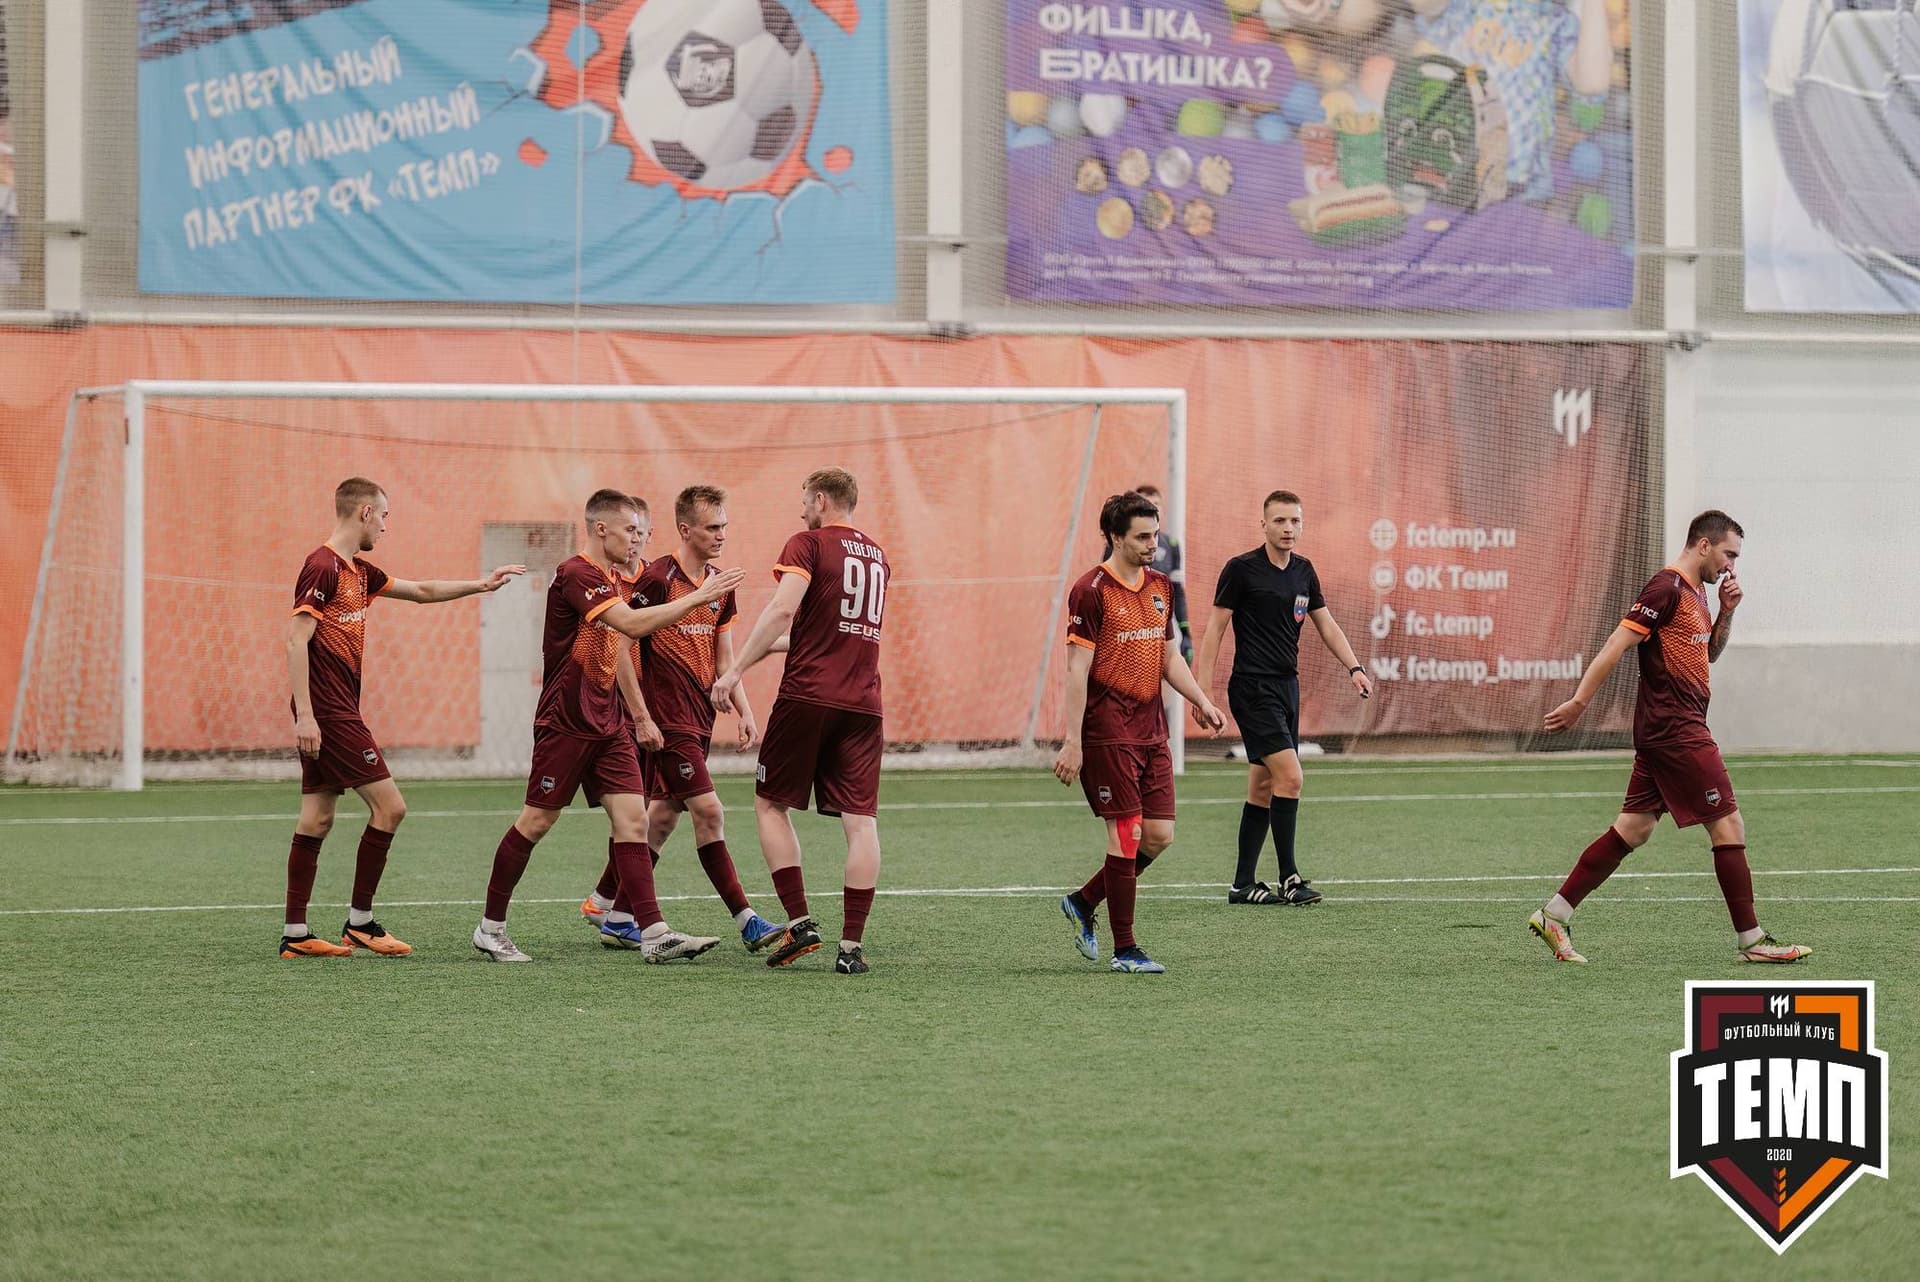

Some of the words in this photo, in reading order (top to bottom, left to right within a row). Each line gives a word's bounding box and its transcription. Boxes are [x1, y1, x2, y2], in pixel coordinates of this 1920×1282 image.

[1039, 3, 1212, 48] ФИШКА,
[184, 34, 401, 121] ГЕНЕРАЛЬНЫЙ
[1039, 48, 1274, 89] БРАТИШКА?
[185, 80, 480, 190] ИНФОРМАЦИОННЫЙ
[183, 185, 321, 250] ПАРТНЕР
[328, 170, 382, 216] ФК
[388, 148, 501, 201] «ТЕМП»
[1406, 521, 1517, 553] fctemp.ru
[840, 556, 885, 625] 90
[1404, 564, 1443, 591] ФК
[1448, 565, 1508, 590] Темп
[1405, 609, 1494, 640] fc.temp
[1641, 606, 1659, 620] ПСБ
[1406, 653, 1583, 686] fctemp_barnaul
